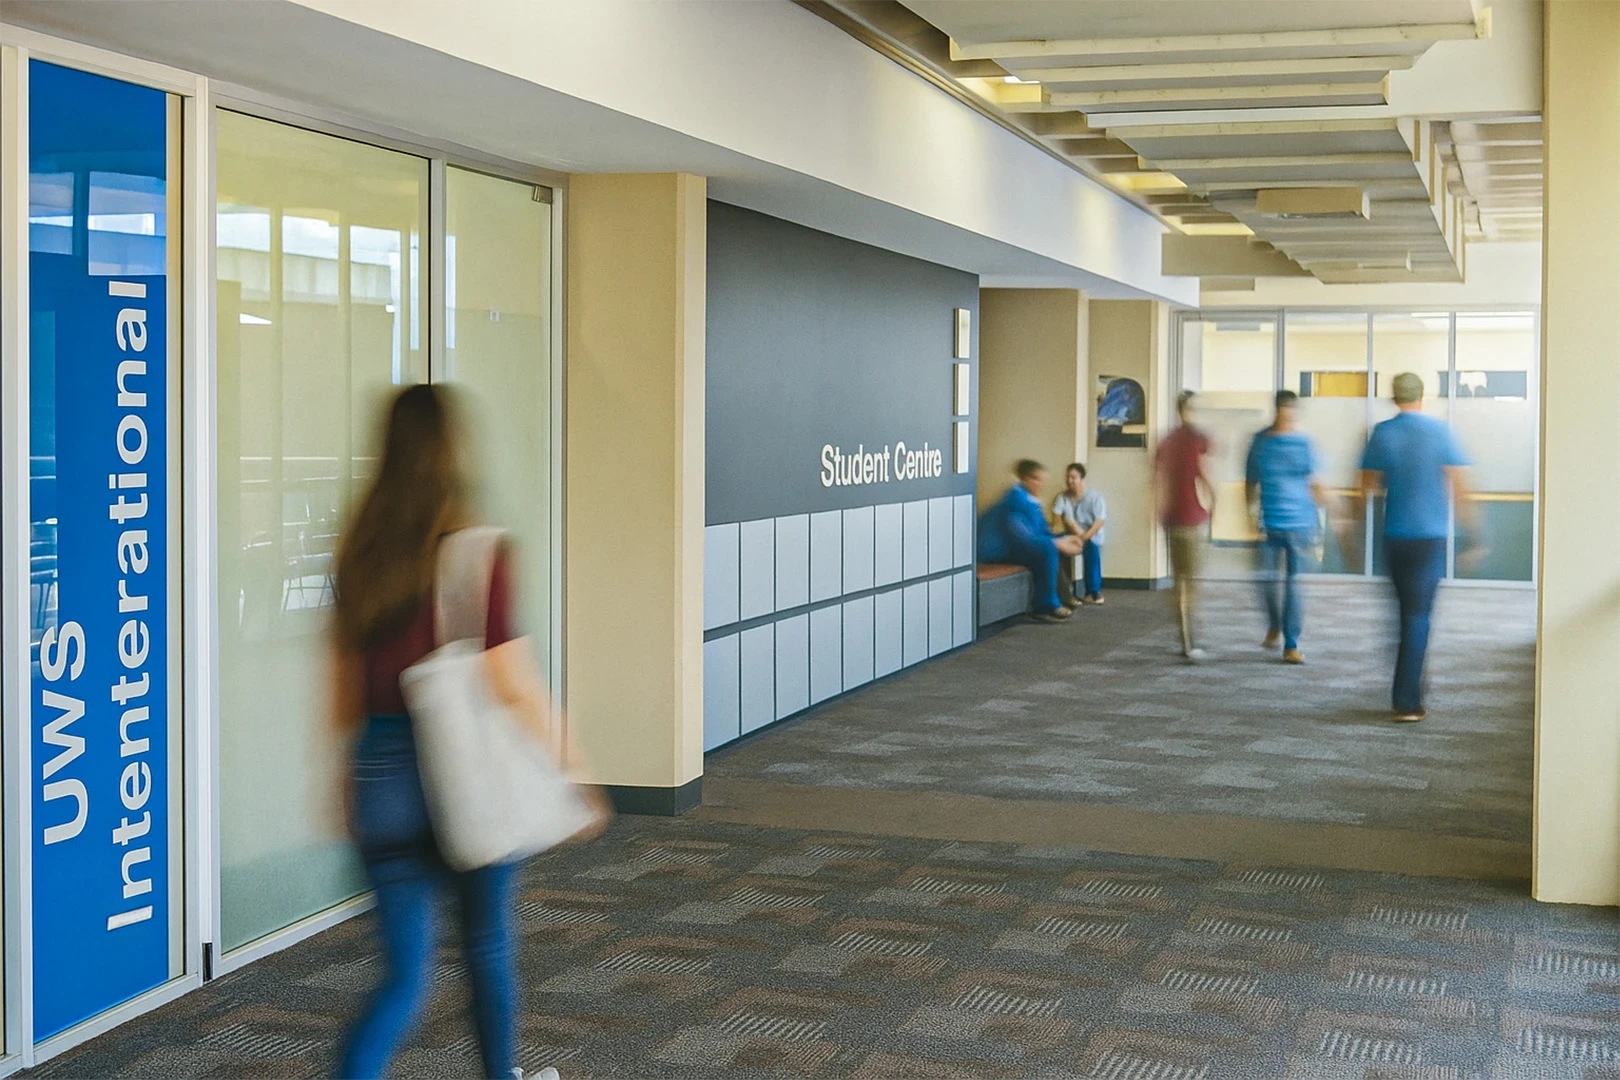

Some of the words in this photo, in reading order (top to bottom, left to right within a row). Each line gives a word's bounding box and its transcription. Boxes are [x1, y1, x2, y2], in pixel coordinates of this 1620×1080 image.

[820, 444, 890, 488] Student
[894, 441, 942, 481] Centre
[107, 280, 153, 931] Intenterational
[40, 620, 89, 846] UWS
